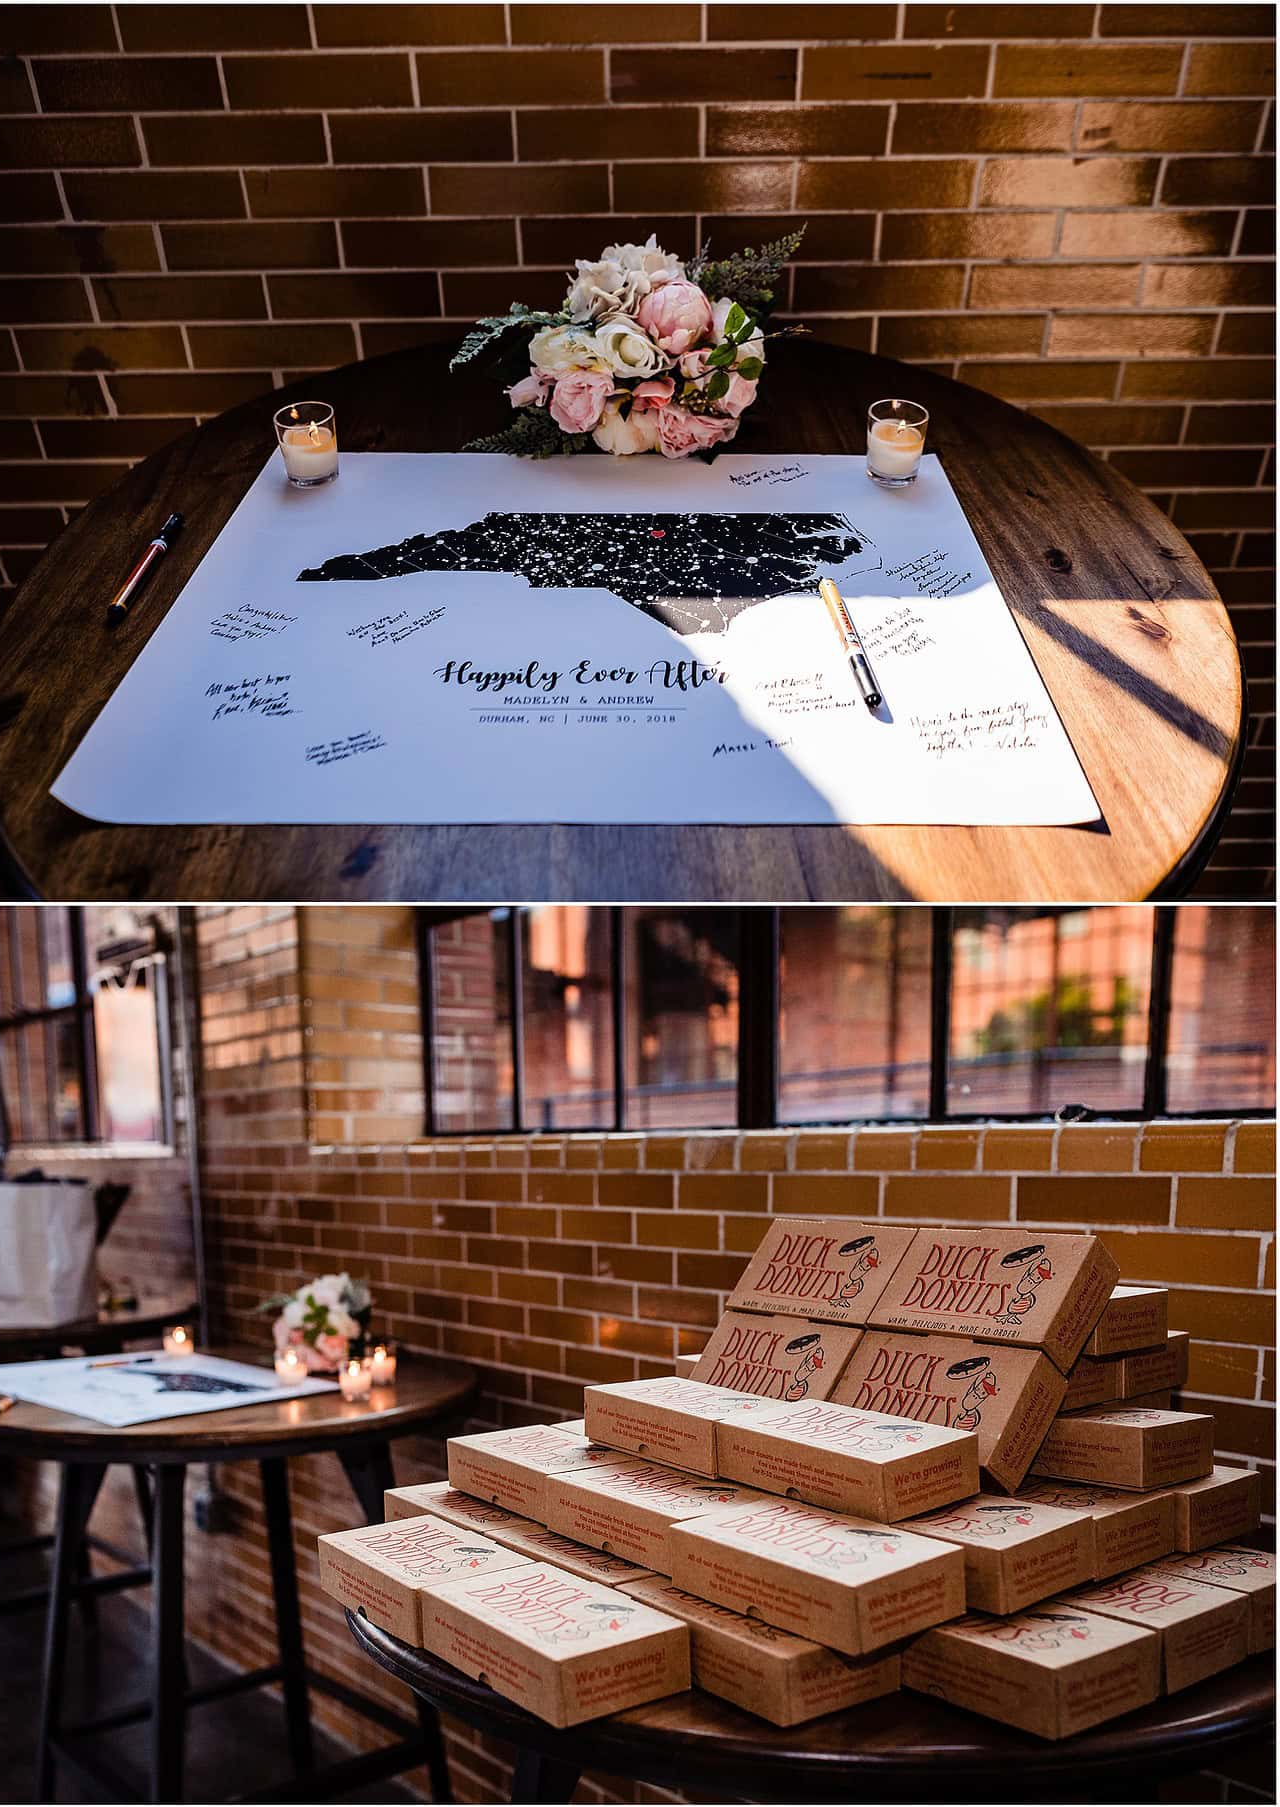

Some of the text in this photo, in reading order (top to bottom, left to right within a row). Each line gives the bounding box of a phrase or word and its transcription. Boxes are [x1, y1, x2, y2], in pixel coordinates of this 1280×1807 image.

[432, 659, 731, 692] Happily Ever After
[503, 695, 655, 705] MADELYN & ANDREW
[539, 715, 555, 724] NC
[577, 715, 609, 724] JUNE
[646, 715, 677, 724] 2018
[771, 1234, 838, 1268] DUCK
[918, 1244, 1000, 1282] DUCK
[753, 1264, 845, 1301] DONUTS
[900, 1277, 1012, 1317] DONUTS
[888, 1317, 908, 1325] WARM
[912, 1319, 947, 1330] DELICIOUS
[959, 1325, 978, 1335] MADE
[982, 1327, 991, 1336] TO
[992, 1329, 1020, 1338] ORDER!
[720, 1327, 784, 1367] DUCK
[706, 1358, 791, 1400] DONUTS
[864, 1348, 944, 1392] DUCK
[790, 1406, 877, 1432] DUCK
[852, 1383, 957, 1429] DONUTS
[1020, 1382, 1044, 1432] growing!
[758, 1416, 873, 1447] DONUTS
[587, 1474, 688, 1503] DONUTS
[620, 1467, 698, 1490] DUCK
[894, 1455, 961, 1487] We're growing!
[717, 1515, 844, 1556] DONUTS
[753, 1505, 848, 1533] DUCK
[355, 1532, 445, 1568] DONUTS
[392, 1523, 465, 1552] DUCK
[466, 1583, 577, 1633] DONUTS
[504, 1573, 593, 1612] DUCK
[575, 1649, 667, 1685] We're growing!
